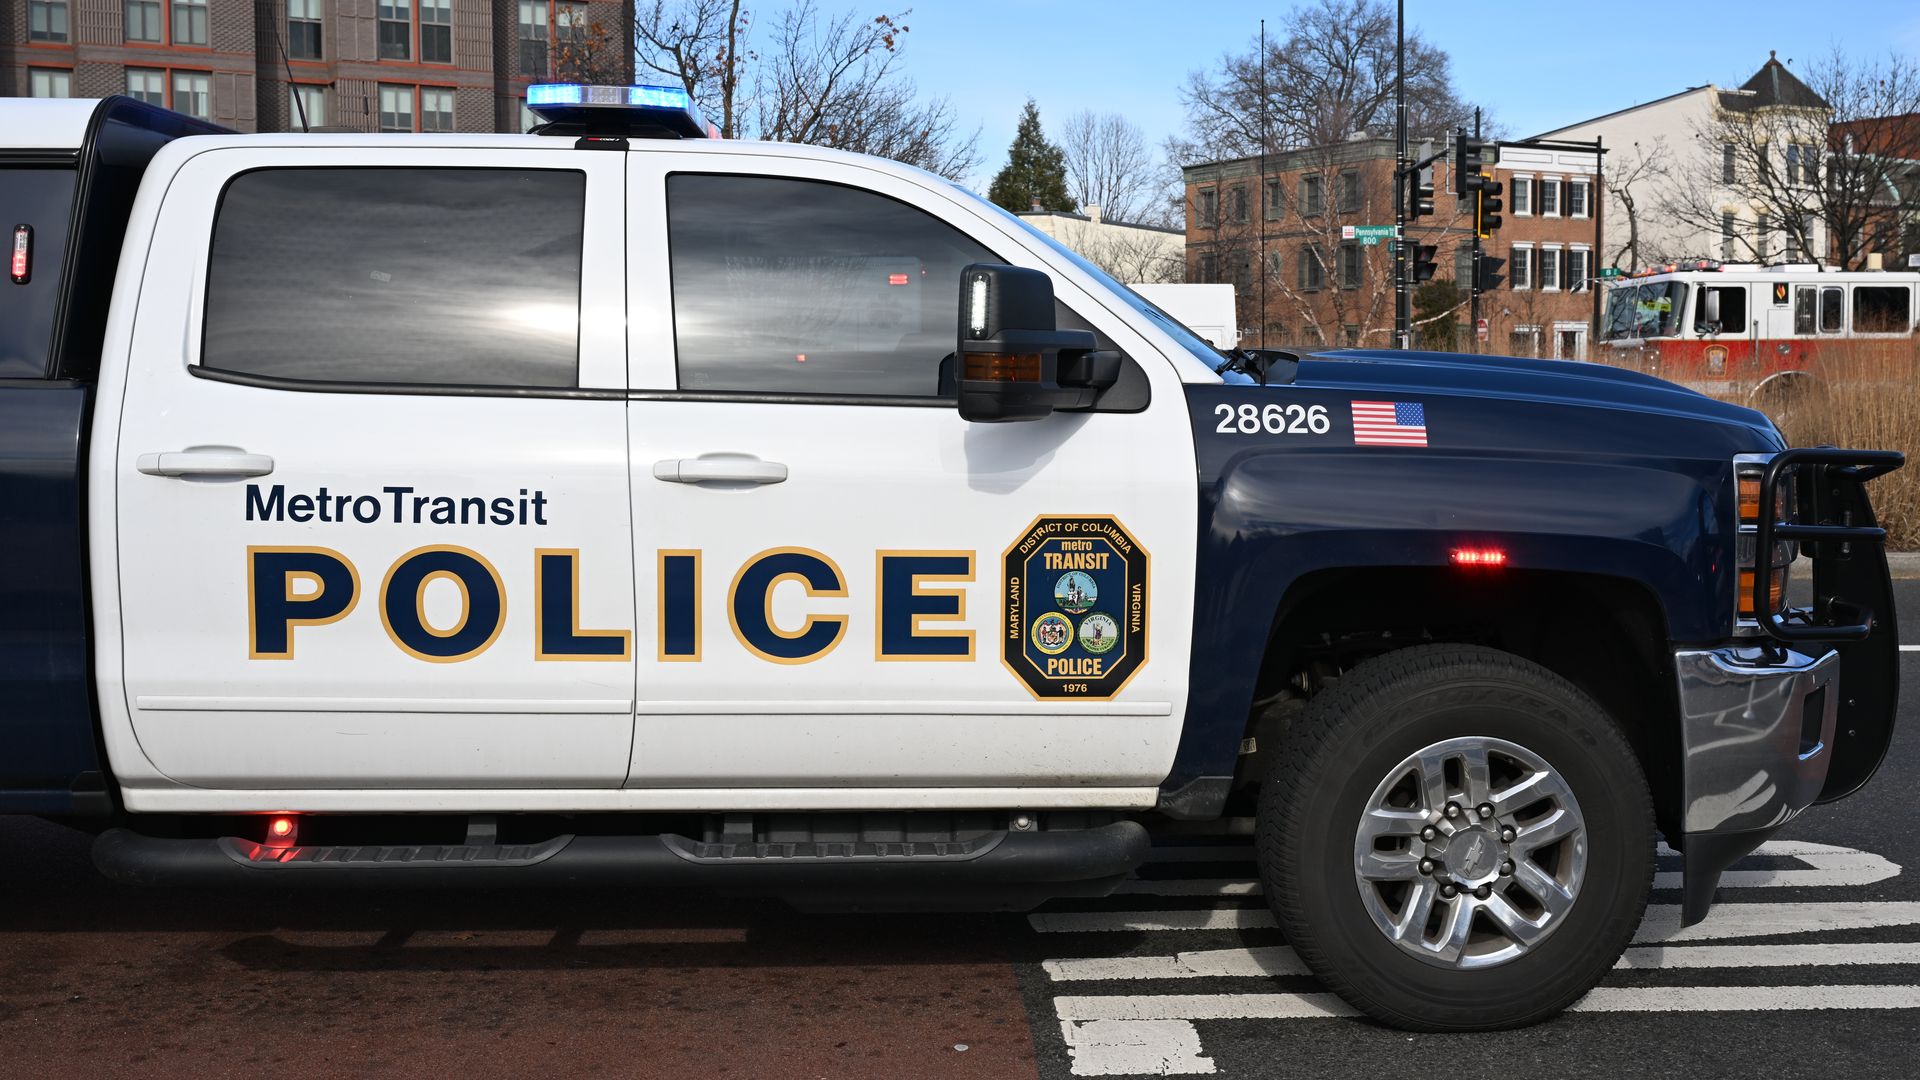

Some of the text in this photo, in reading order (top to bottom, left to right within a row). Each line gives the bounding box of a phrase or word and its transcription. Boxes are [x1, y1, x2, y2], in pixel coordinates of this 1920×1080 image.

[1355, 228, 1389, 237] Pennsylvania
[1363, 237, 1377, 245] 800
[1214, 403, 1330, 434] 28626
[245, 484, 548, 525] MetroTransit
[1019, 523, 1132, 554] DISTRICT OF COLUMBIA
[1061, 540, 1093, 551] metro
[1043, 552, 1110, 570] TRANSIT
[247, 544, 976, 665] POLICE
[1010, 576, 1020, 639] MARYLAND
[1131, 583, 1141, 633] VIRGINIA
[1084, 615, 1112, 626] VIRGINIA
[1047, 658, 1102, 675] POLICE
[1062, 683, 1088, 692] 1976
